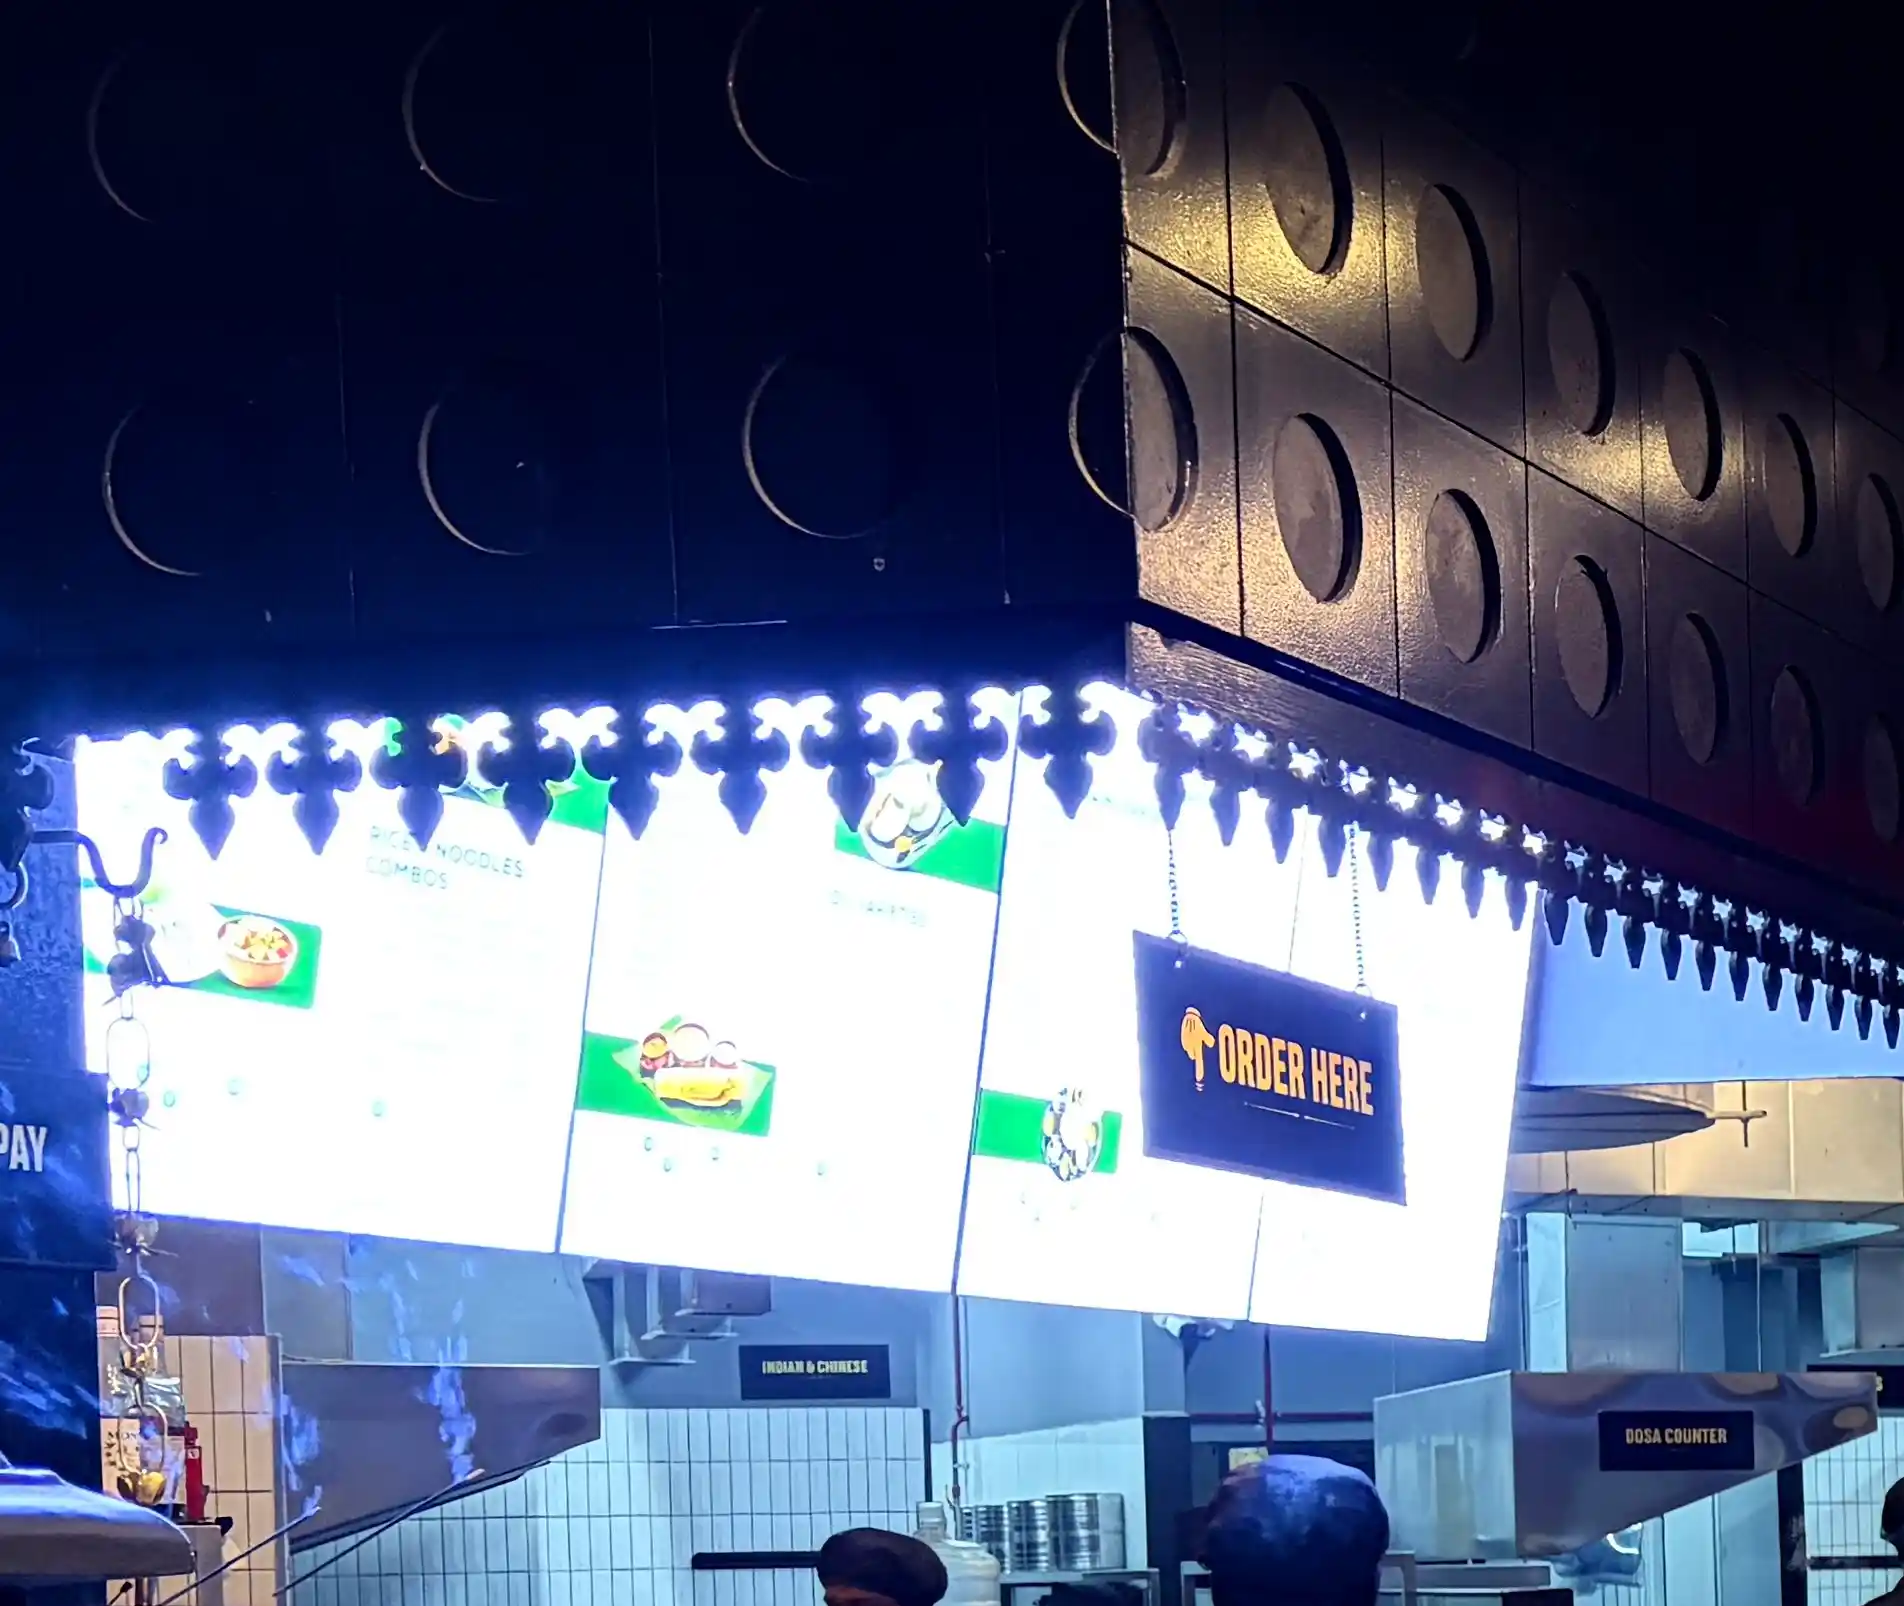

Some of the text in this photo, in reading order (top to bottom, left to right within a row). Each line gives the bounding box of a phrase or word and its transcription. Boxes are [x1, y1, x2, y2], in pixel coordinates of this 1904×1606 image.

[366, 856, 448, 890] COMBOS
[1218, 1023, 1374, 1116] ORDER HERE
[1626, 1428, 1727, 1444] DOSA COUNTER
